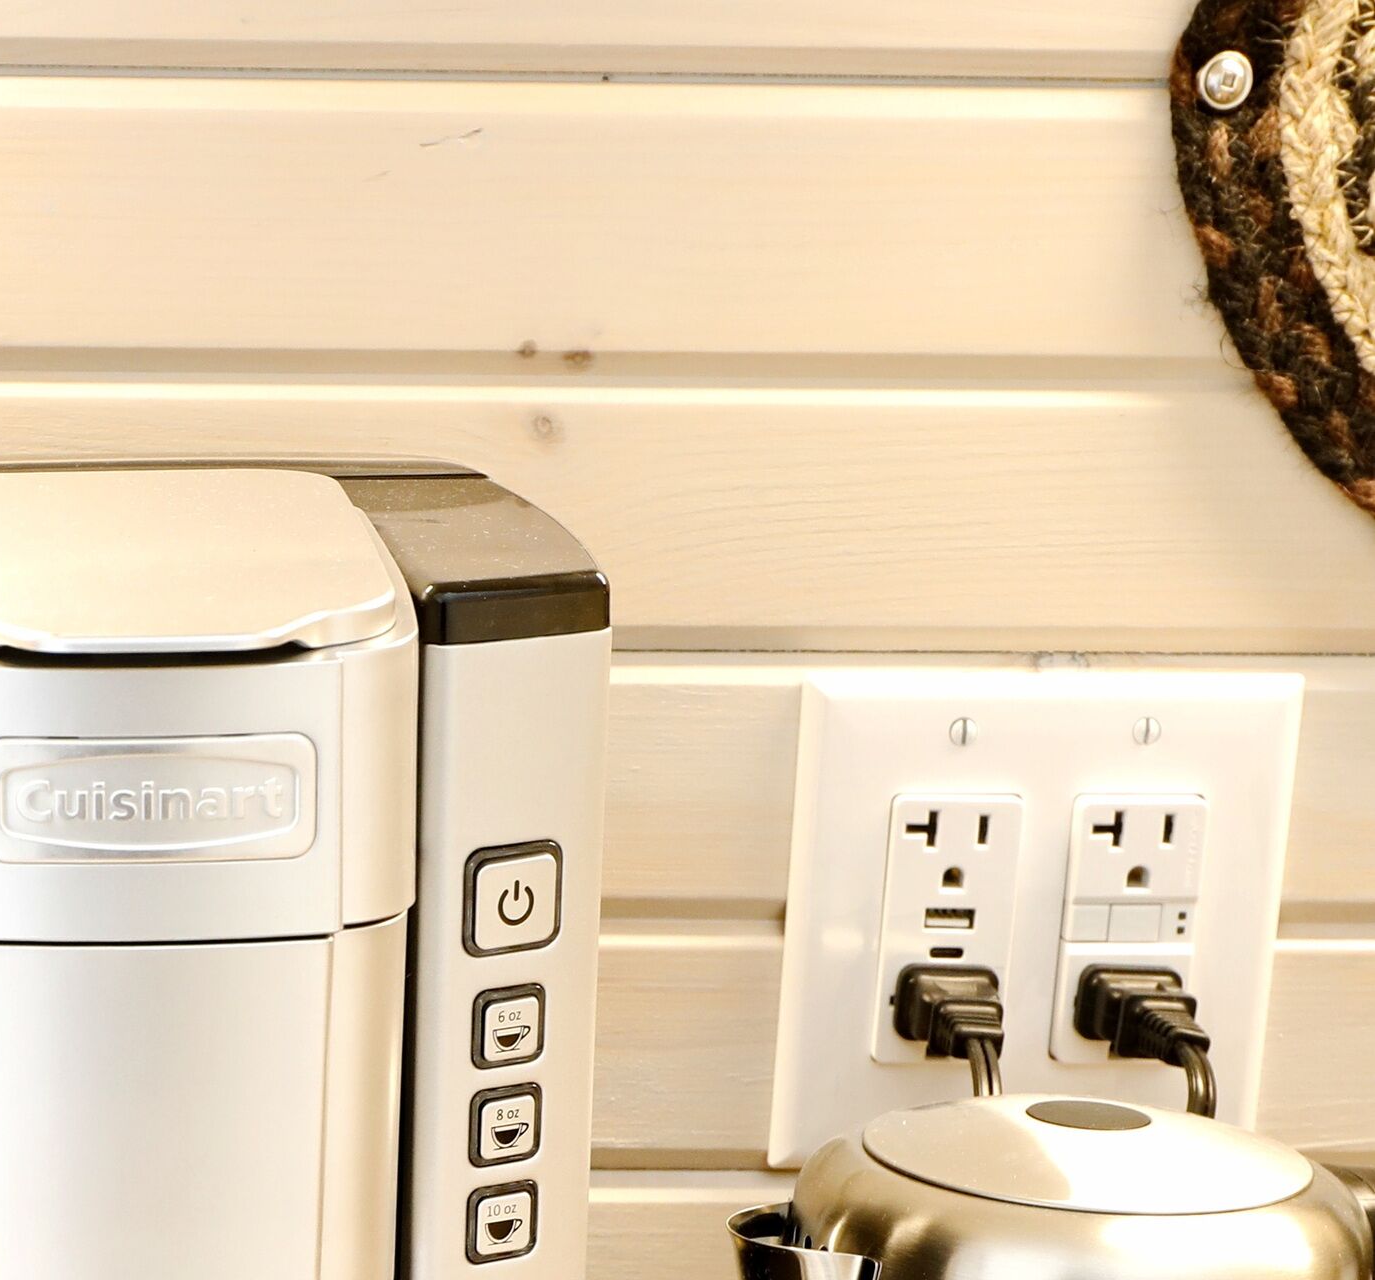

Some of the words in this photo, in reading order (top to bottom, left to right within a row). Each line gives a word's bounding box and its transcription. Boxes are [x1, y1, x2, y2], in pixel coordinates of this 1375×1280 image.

[13, 776, 284, 825] Cuisinart
[497, 1010, 506, 1024] 6
[508, 1010, 522, 1022] oz
[496, 1108, 504, 1121] 8
[506, 1108, 520, 1120] oz
[487, 1204, 501, 1218] 10
[504, 1203, 517, 1215] oz
